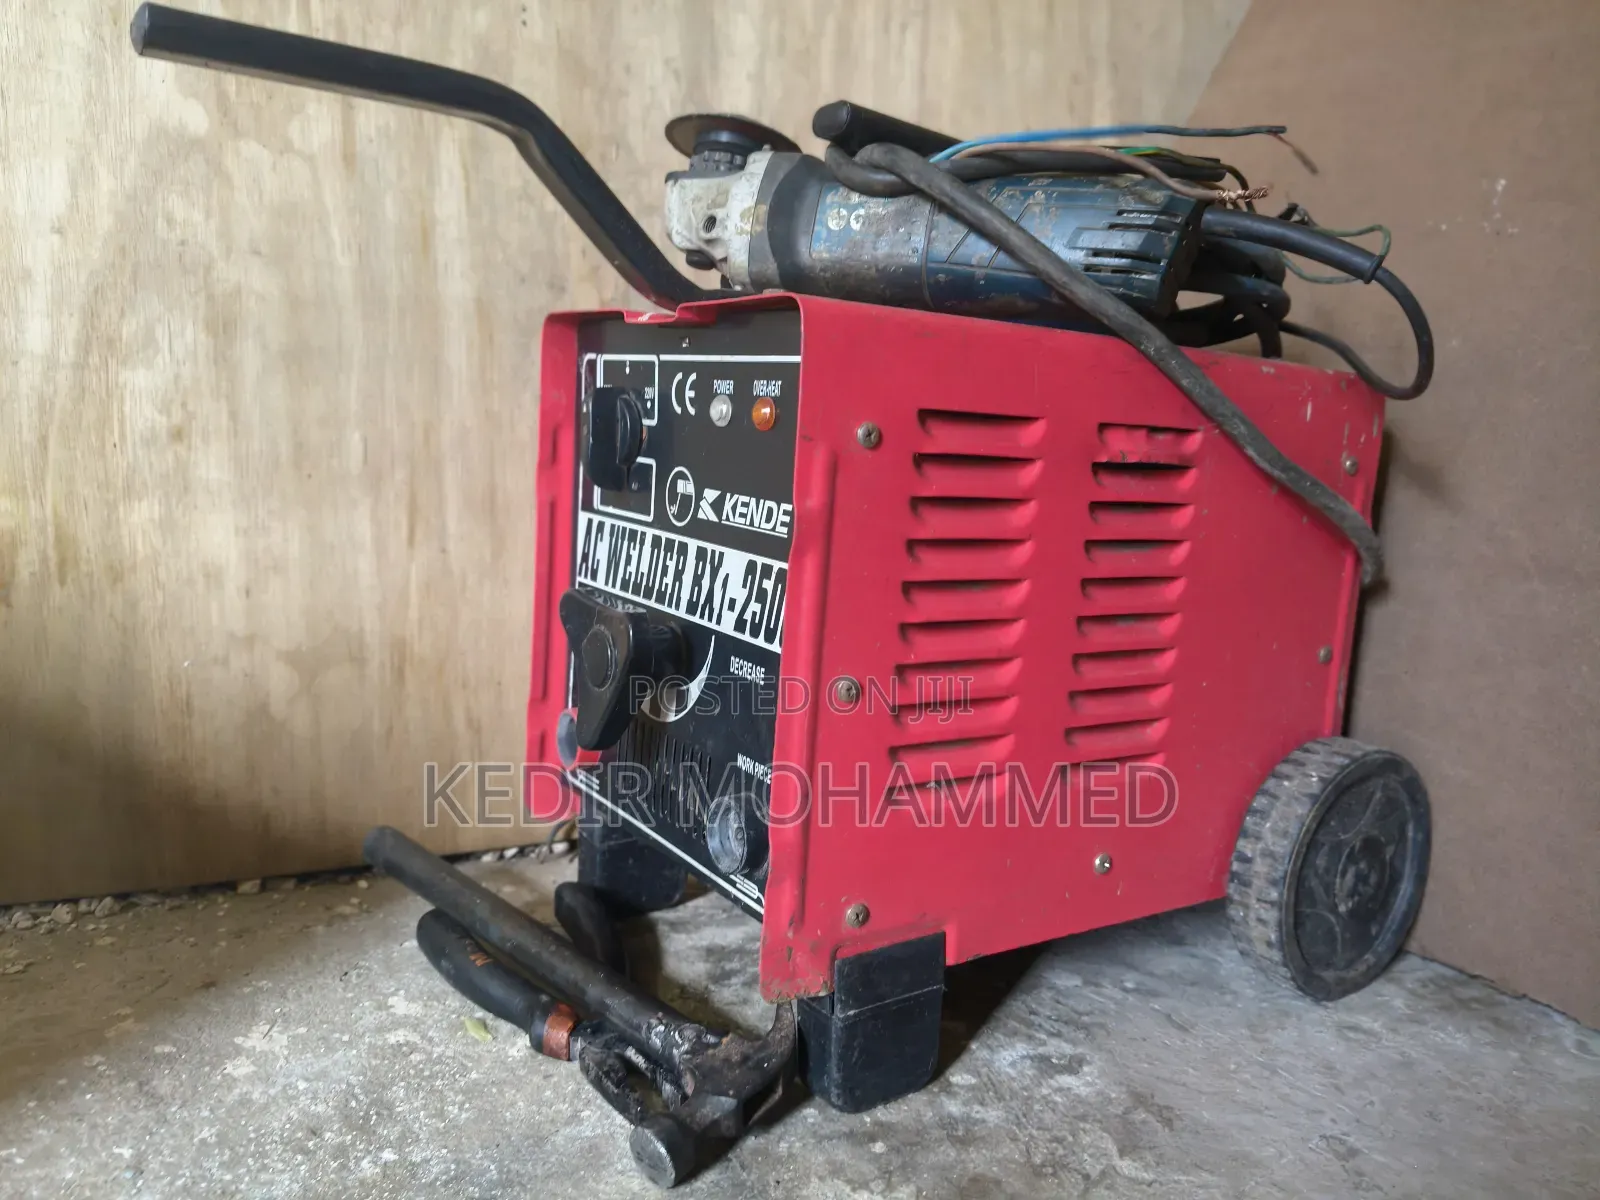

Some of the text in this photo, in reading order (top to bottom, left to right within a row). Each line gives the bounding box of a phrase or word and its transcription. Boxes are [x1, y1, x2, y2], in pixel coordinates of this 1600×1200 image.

[713, 379, 734, 395] POWER
[753, 379, 782, 397] OVER-HEAT
[722, 492, 793, 534] KENDE
[578, 517, 788, 649] AC WELDER BX1-250
[730, 655, 765, 685] DECREASE
[737, 752, 772, 785] WORK PIECE
